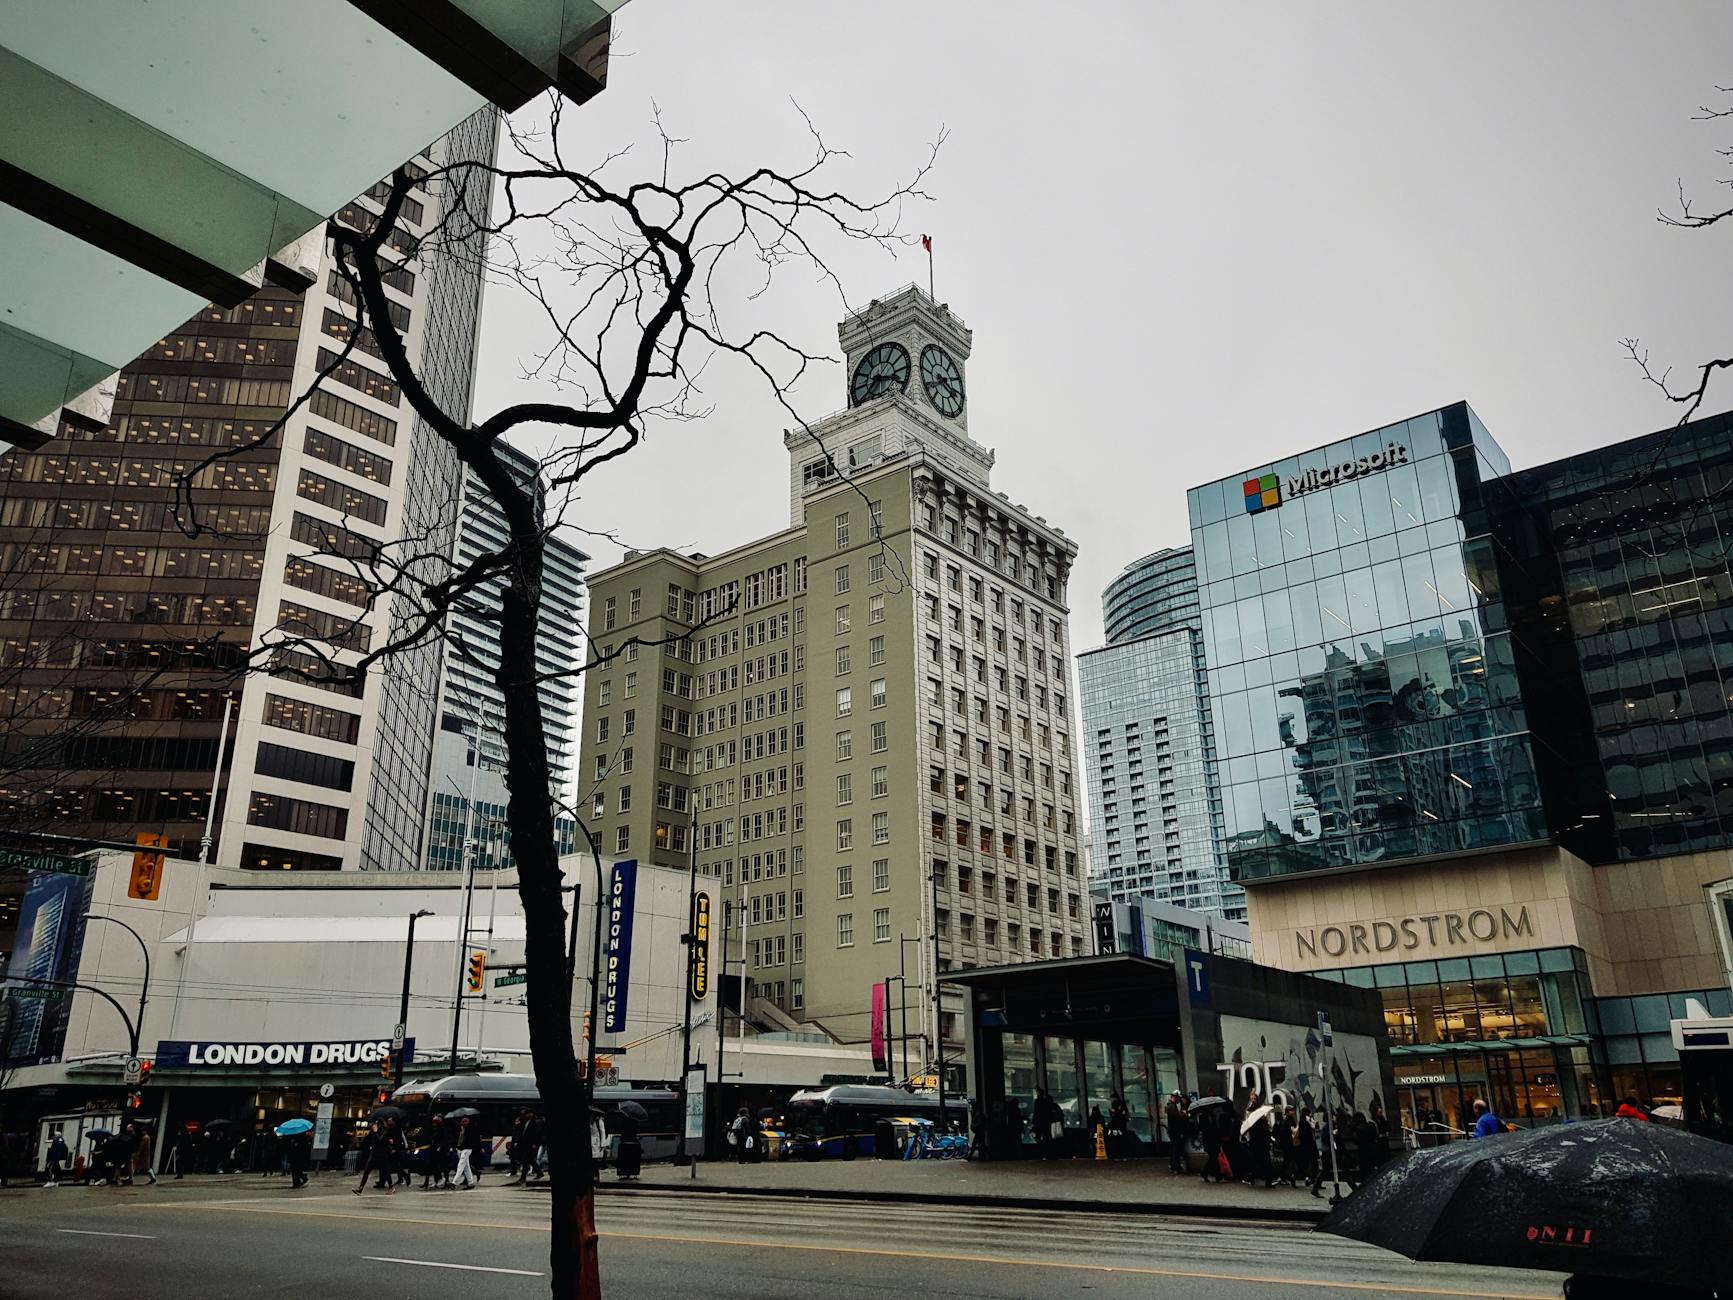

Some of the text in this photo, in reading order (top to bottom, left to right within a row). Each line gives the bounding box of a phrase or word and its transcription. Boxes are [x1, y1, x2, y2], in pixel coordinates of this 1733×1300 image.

[1286, 441, 1407, 497] Microsoft
[697, 898, 708, 941] TOM
[1296, 905, 1534, 959] NORDSTROM
[606, 869, 623, 1028] LONDON DRUGS
[12, 988, 49, 998] Granville
[188, 1042, 391, 1065] LONDON DRUGS
[1400, 1075, 1446, 1085] NORDSTROM
